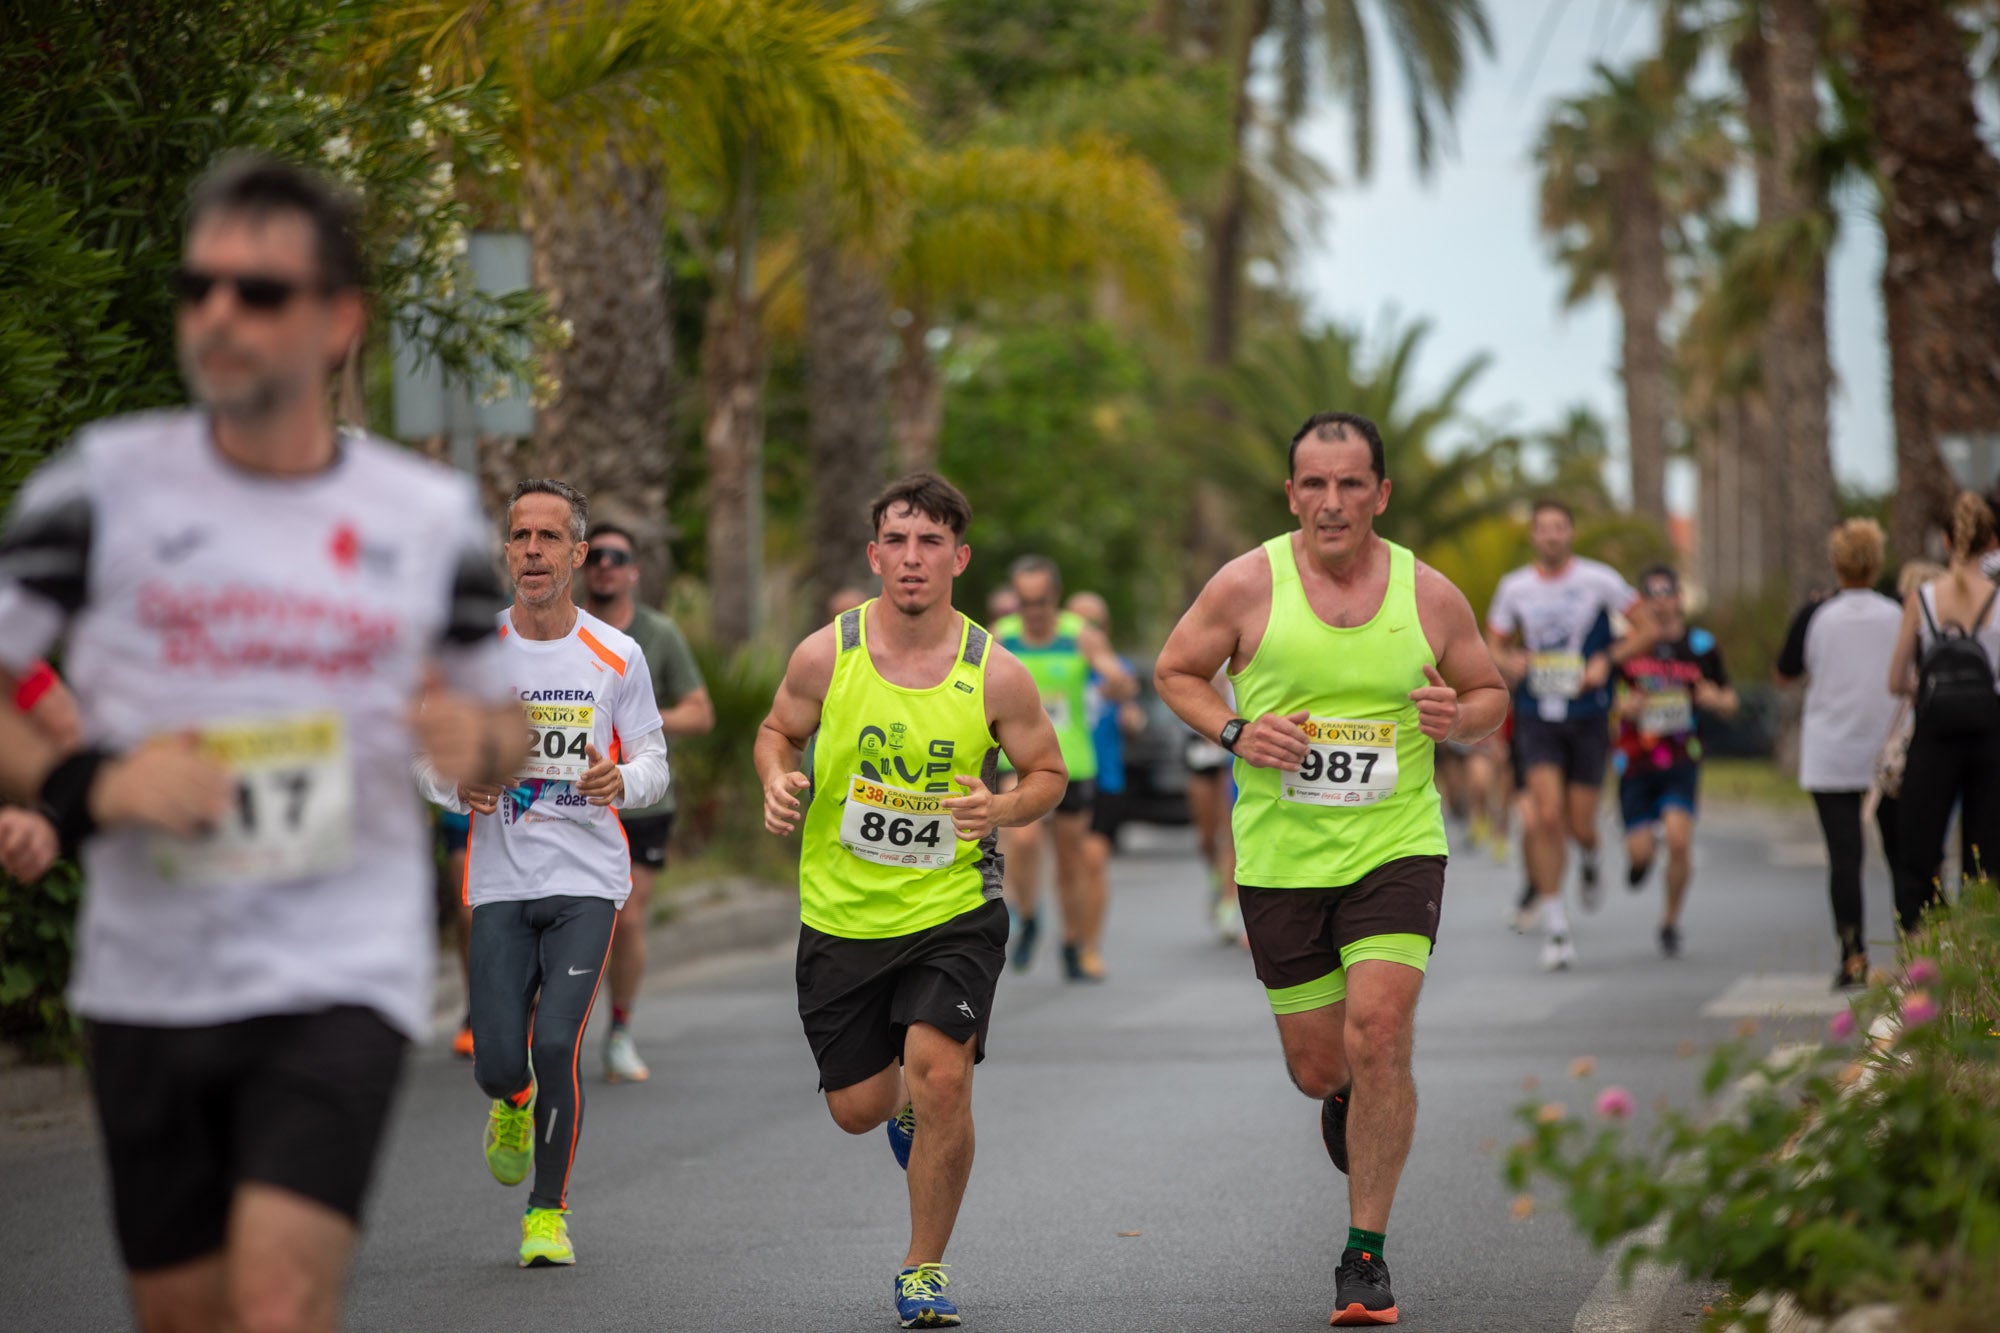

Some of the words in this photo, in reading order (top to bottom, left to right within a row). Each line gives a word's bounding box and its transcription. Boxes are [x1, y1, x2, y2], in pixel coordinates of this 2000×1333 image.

[520, 690, 595, 701] CARRERA
[1318, 729, 1375, 741] FONDO
[1299, 748, 1379, 783] 987
[555, 794, 587, 807] 2025
[866, 786, 884, 803] 38
[887, 790, 908, 800] GRAN
[883, 795, 939, 811] FONDO
[860, 812, 940, 847] 864
